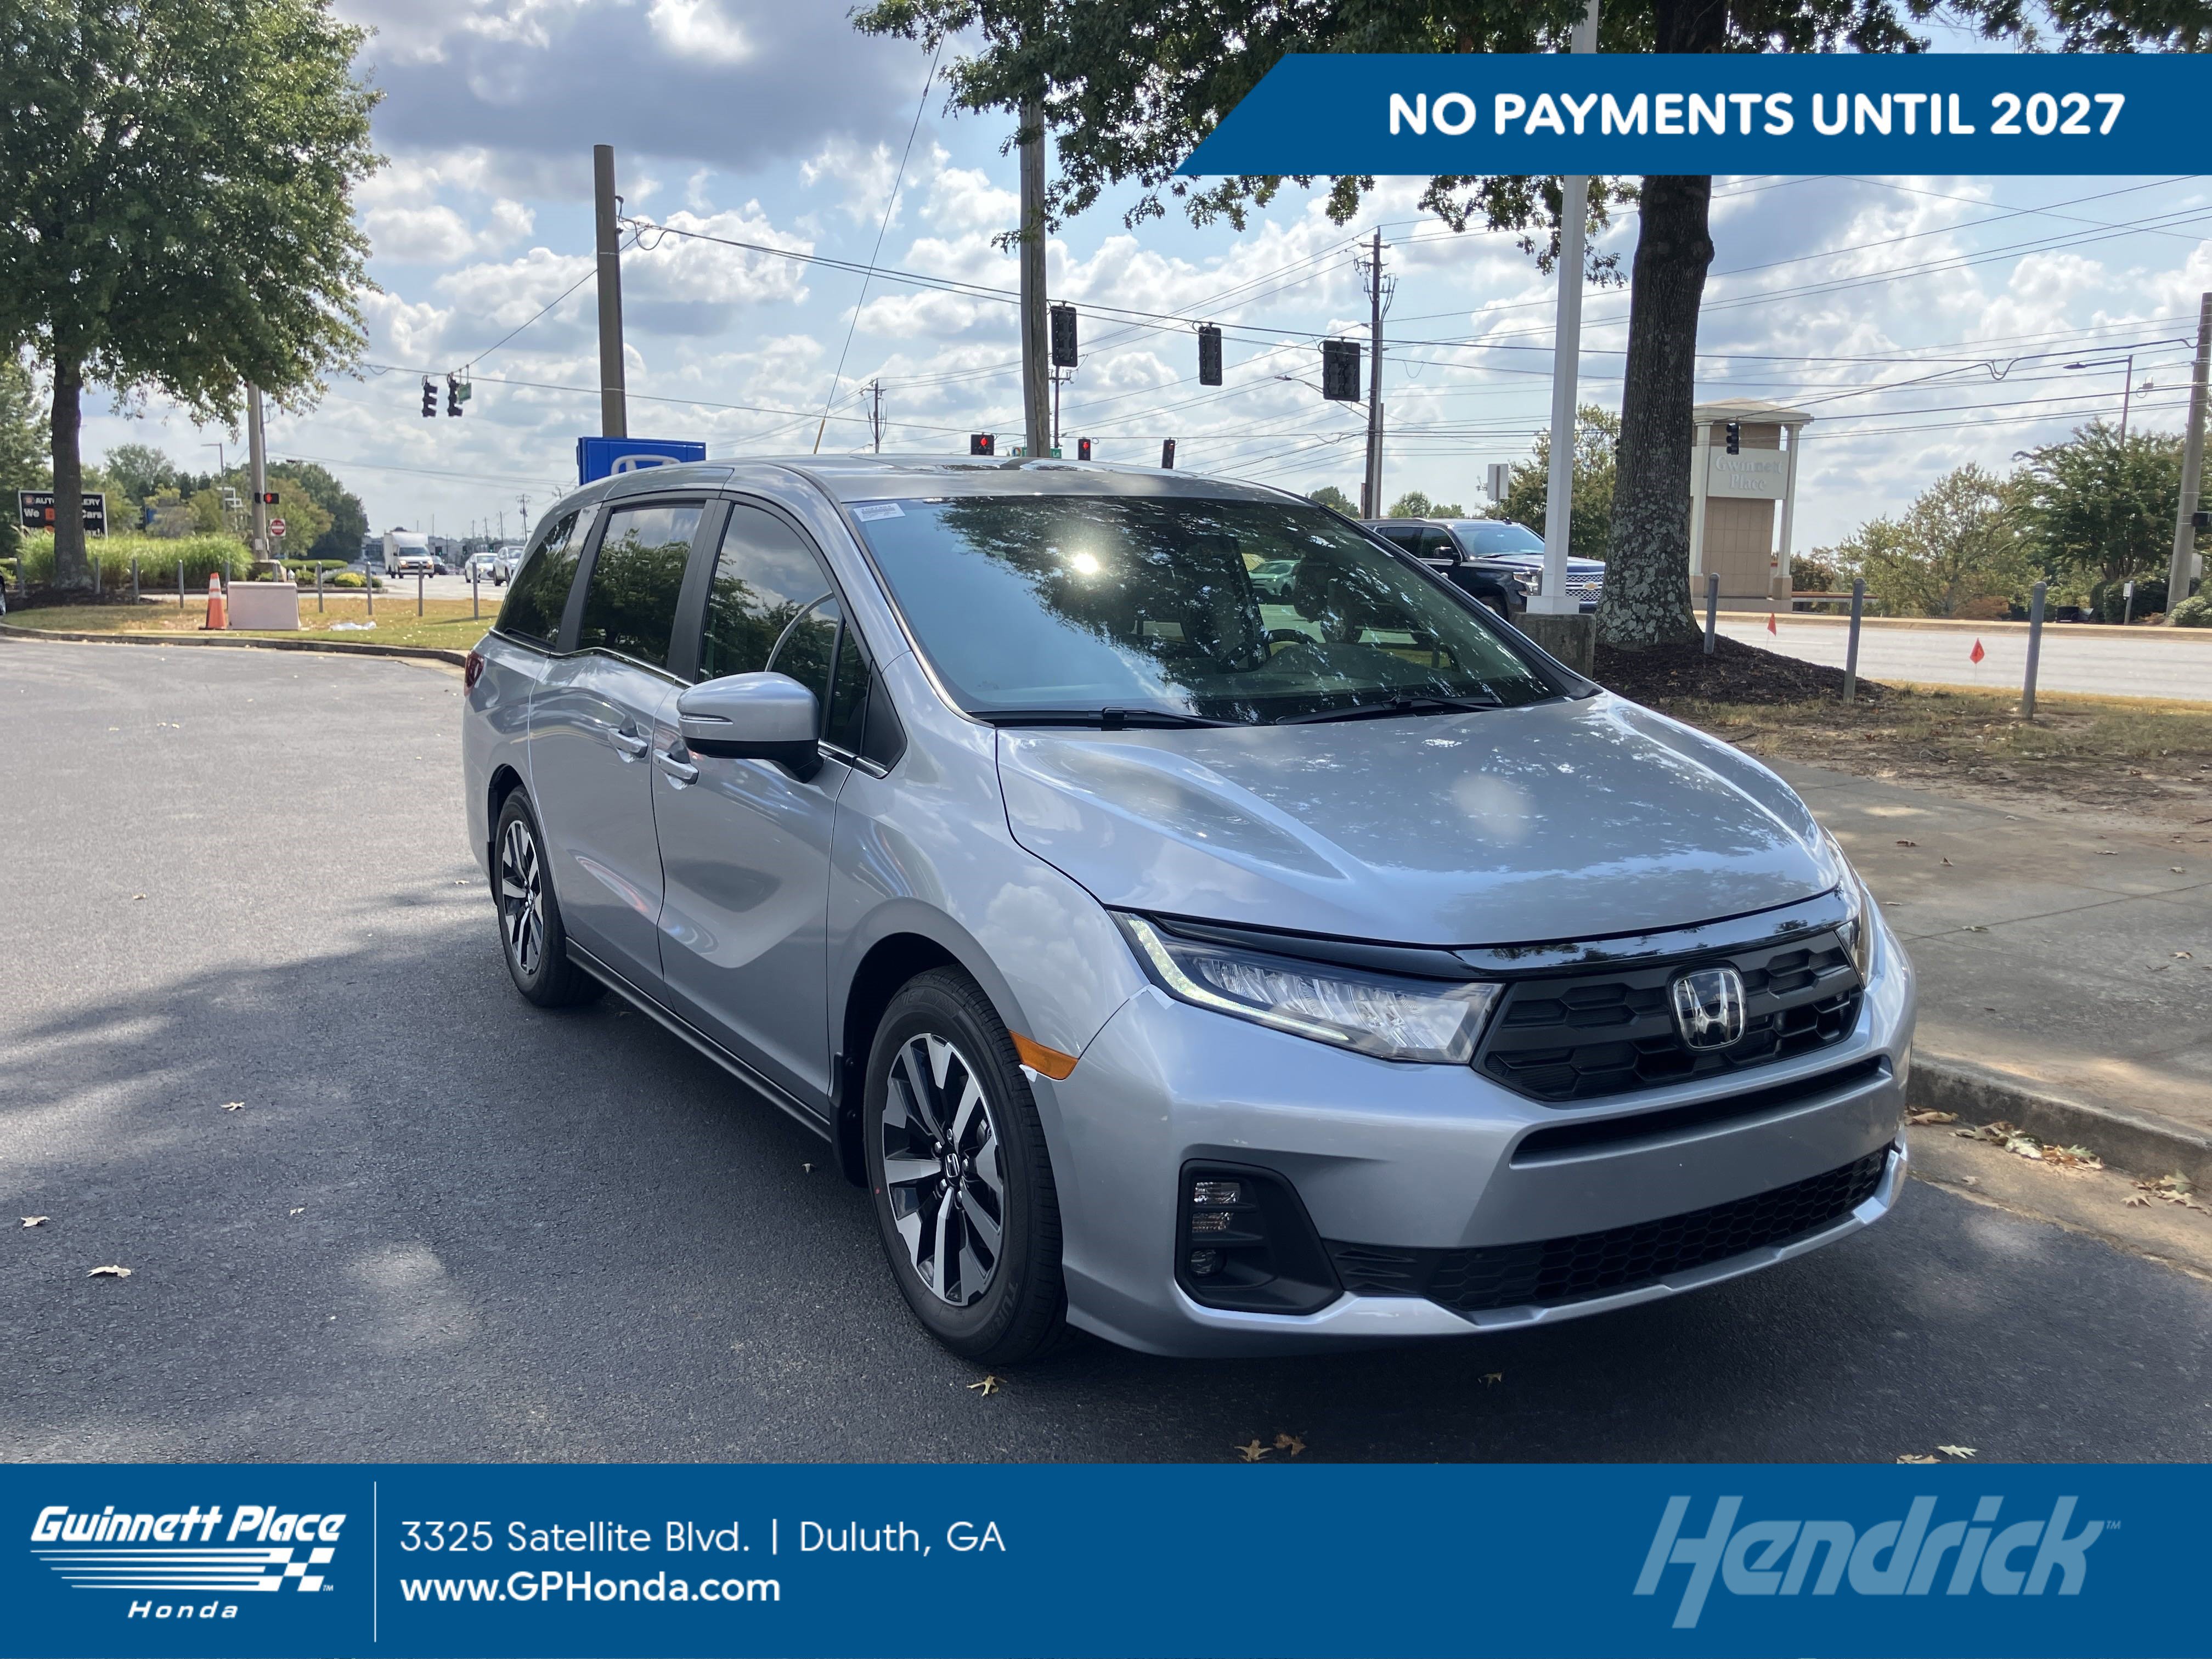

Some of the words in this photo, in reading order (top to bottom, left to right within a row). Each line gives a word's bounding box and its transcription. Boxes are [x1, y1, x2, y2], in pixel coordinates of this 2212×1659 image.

[1716, 455, 1782, 474] Gwinnett
[1729, 473, 1765, 492] Place
[24, 508, 40, 518] We
